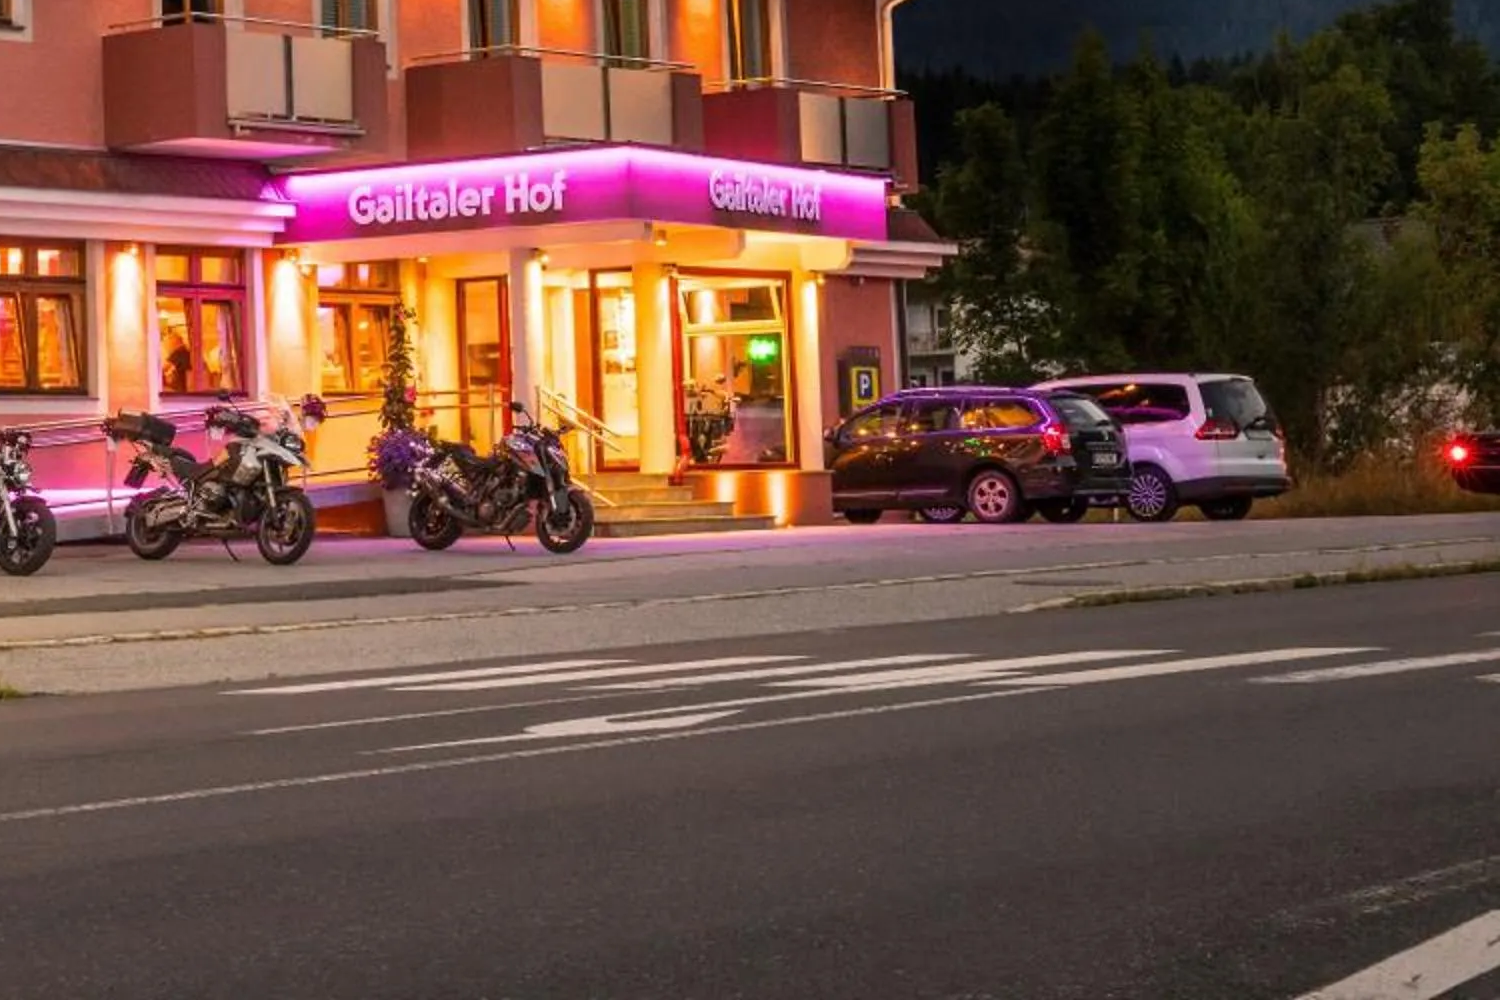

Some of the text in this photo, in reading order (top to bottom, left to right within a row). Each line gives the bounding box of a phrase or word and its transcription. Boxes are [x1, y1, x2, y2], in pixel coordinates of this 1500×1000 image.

[348, 168, 567, 225] Gailtaler Hof
[709, 168, 821, 221] Gailtaler Hof
[860, 372, 871, 397] P
